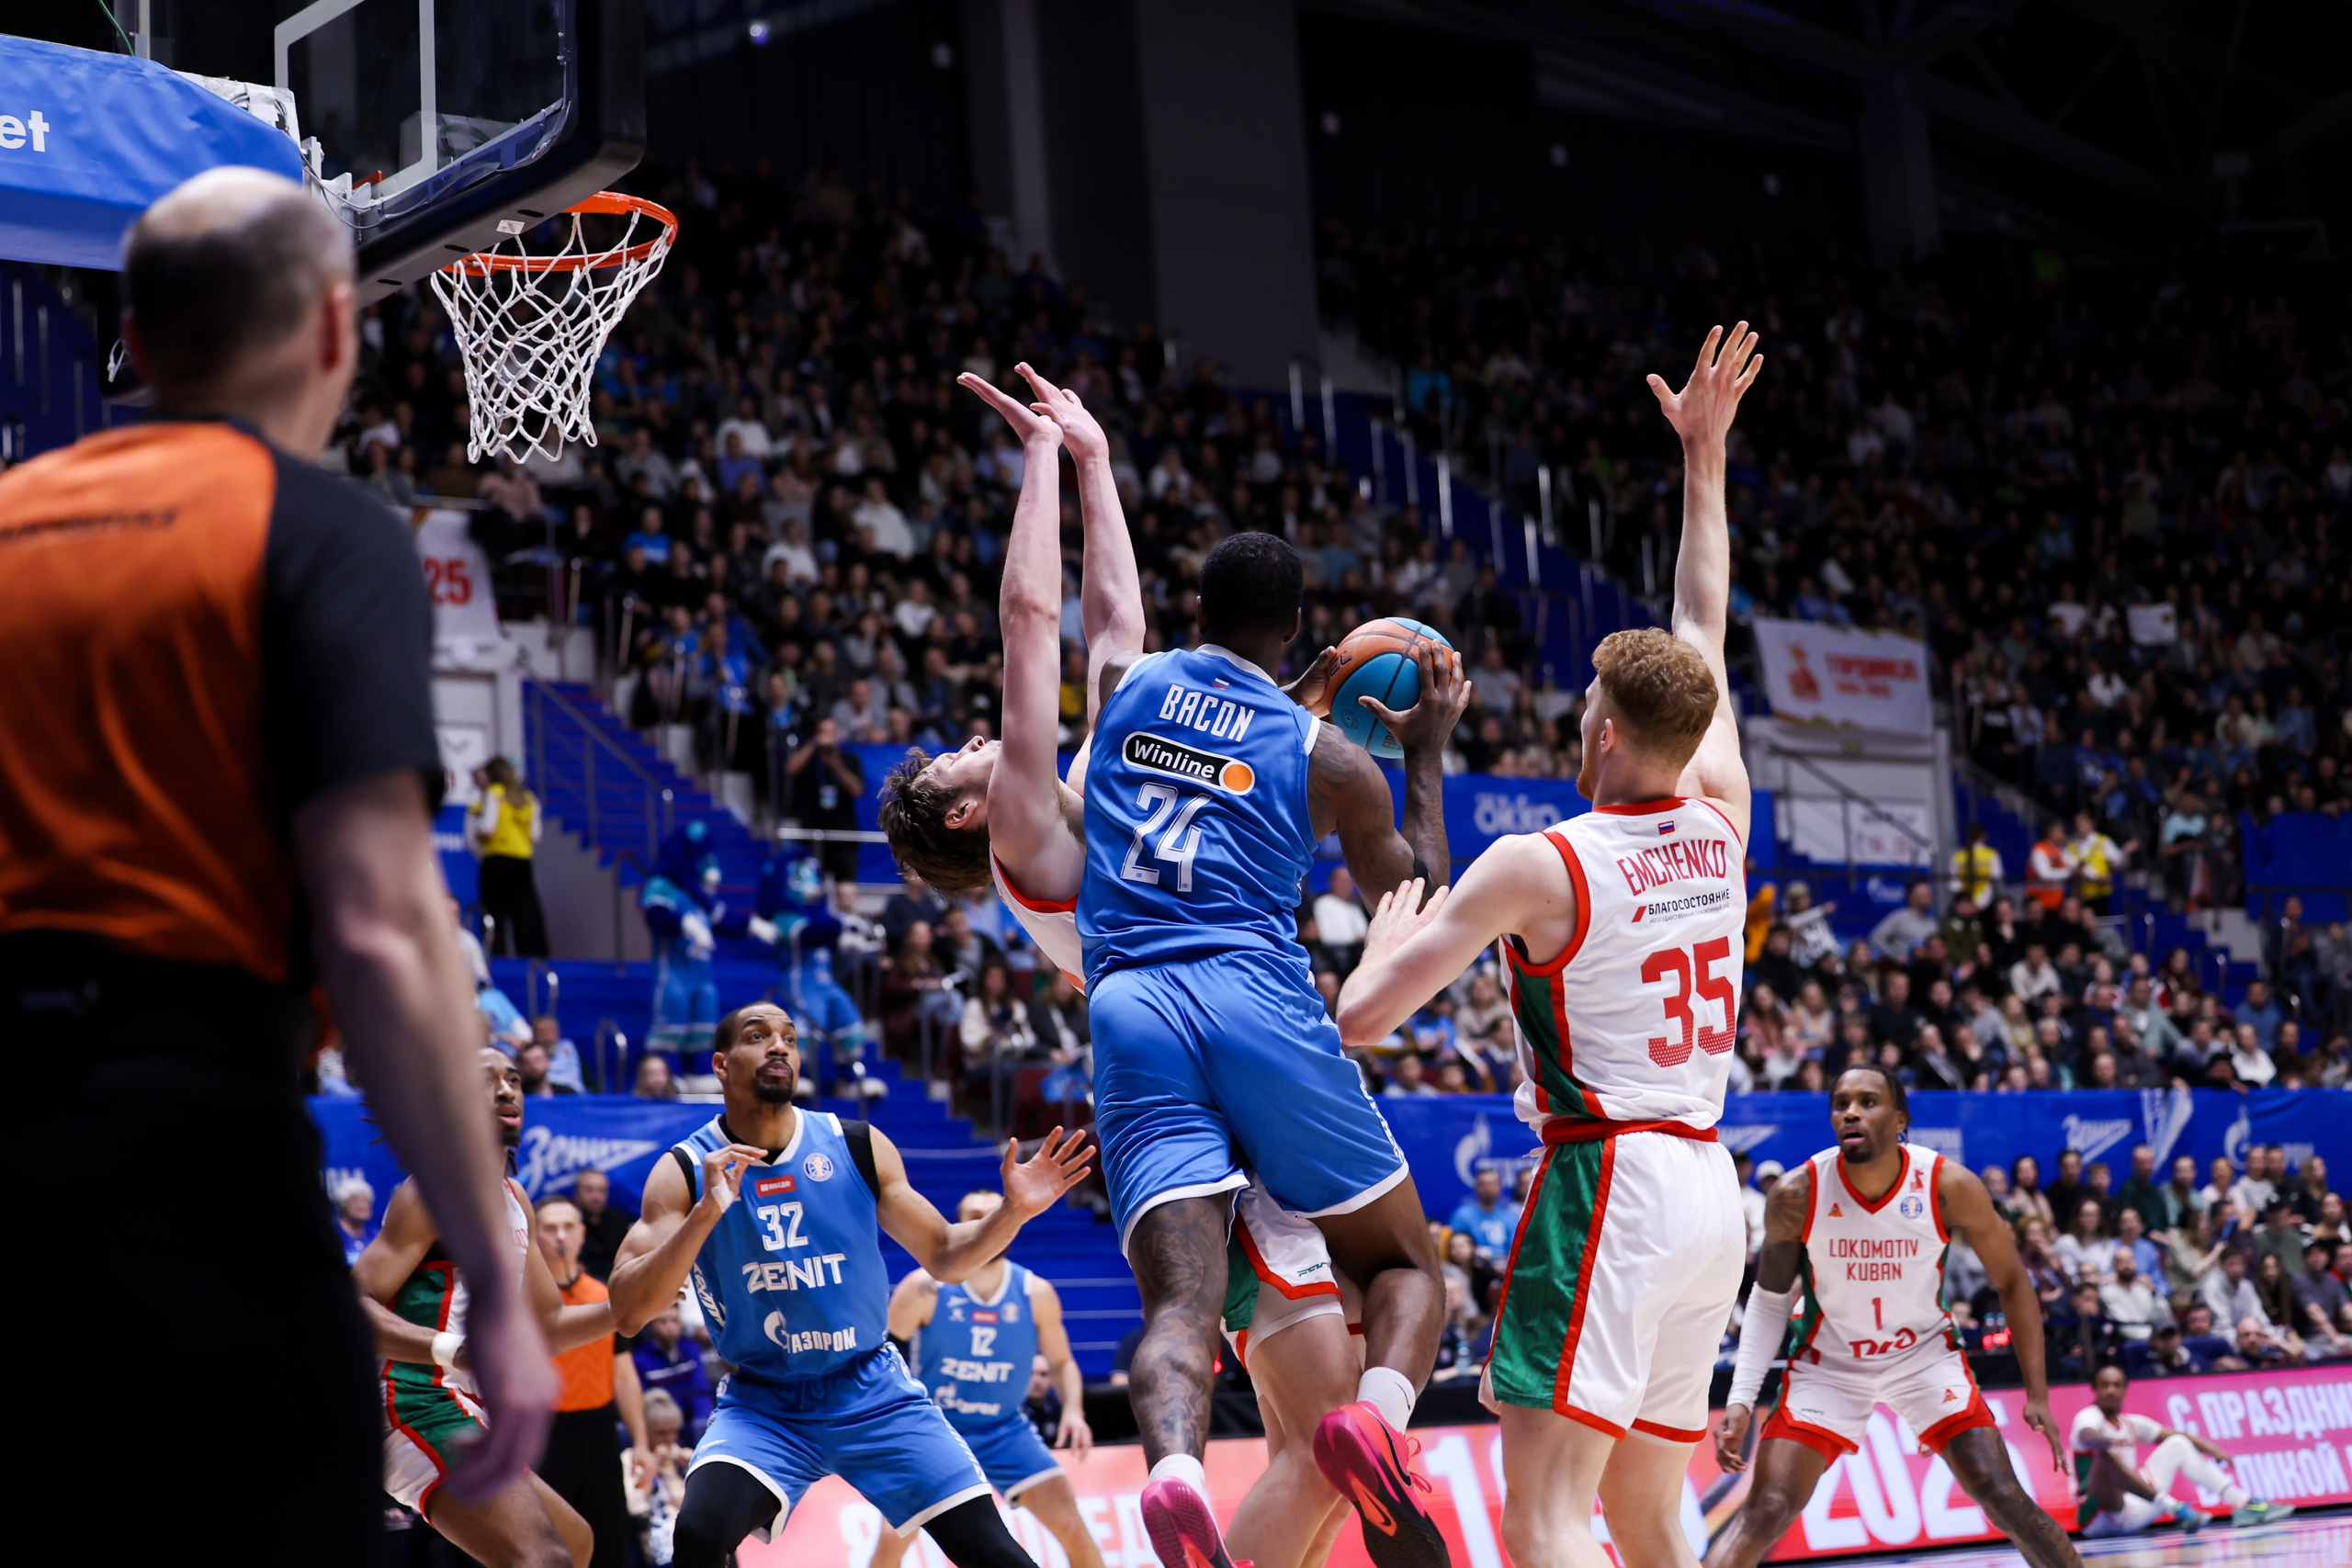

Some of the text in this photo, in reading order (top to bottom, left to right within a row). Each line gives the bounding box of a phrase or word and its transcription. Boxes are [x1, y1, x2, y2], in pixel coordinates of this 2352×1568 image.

[424, 556, 473, 607] 25
[1158, 683, 1256, 742] BACON
[1134, 739, 1216, 780] Winline
[1119, 782, 1215, 893] 24
[1616, 839, 1726, 897] EMCHENKO
[1648, 888, 1730, 916] БЛАГОСОСТОЯНИЕ
[1640, 935, 1736, 1068] 35
[756, 1201, 809, 1252] 32
[1829, 1238, 1918, 1259] LOKOMOTIV
[741, 1252, 847, 1294] ZENIT
[1846, 1261, 1902, 1281] KUBAN
[1871, 1296, 1883, 1331] 1
[969, 1325, 998, 1357] 12
[939, 1356, 1015, 1383] ZENIT
